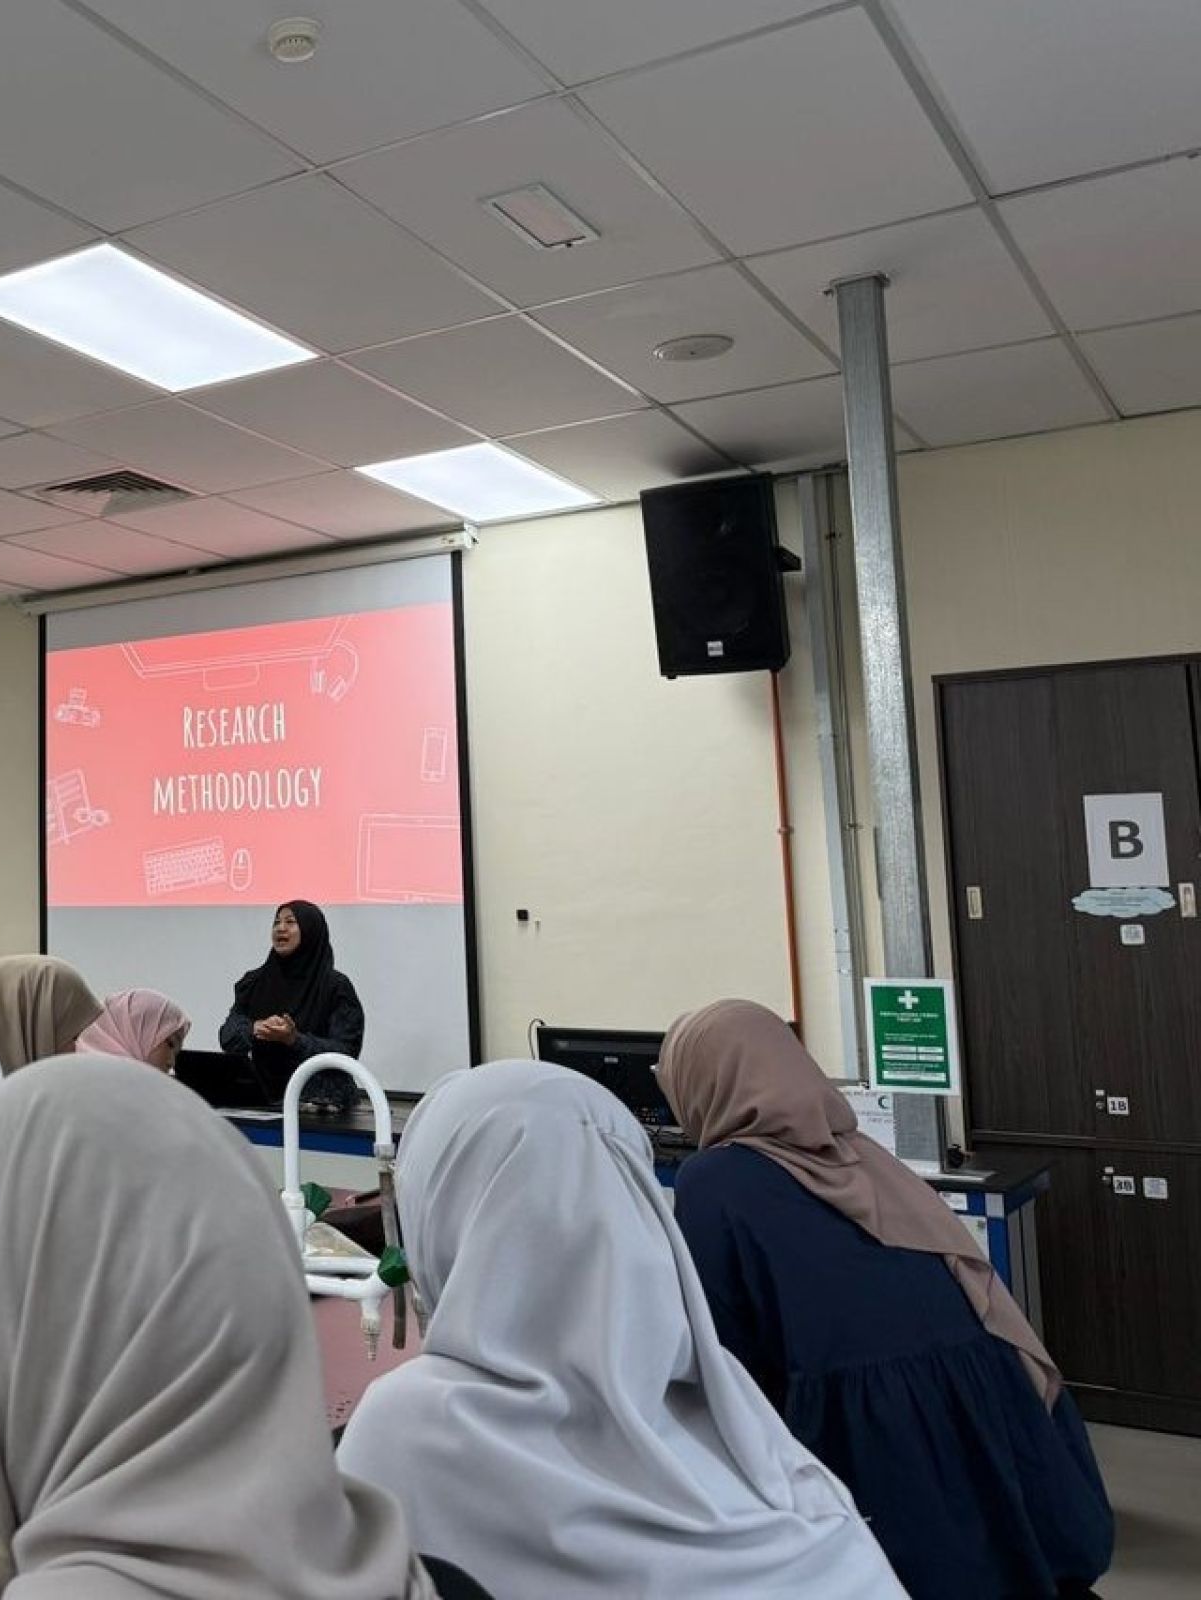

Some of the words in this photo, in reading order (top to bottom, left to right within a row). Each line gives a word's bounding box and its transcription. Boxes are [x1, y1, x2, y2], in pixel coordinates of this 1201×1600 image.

[183, 702, 286, 749] RESEARCH
[153, 766, 322, 816] METHODOLOGY
[1109, 820, 1144, 860] B
[1110, 1100, 1127, 1112] 1B
